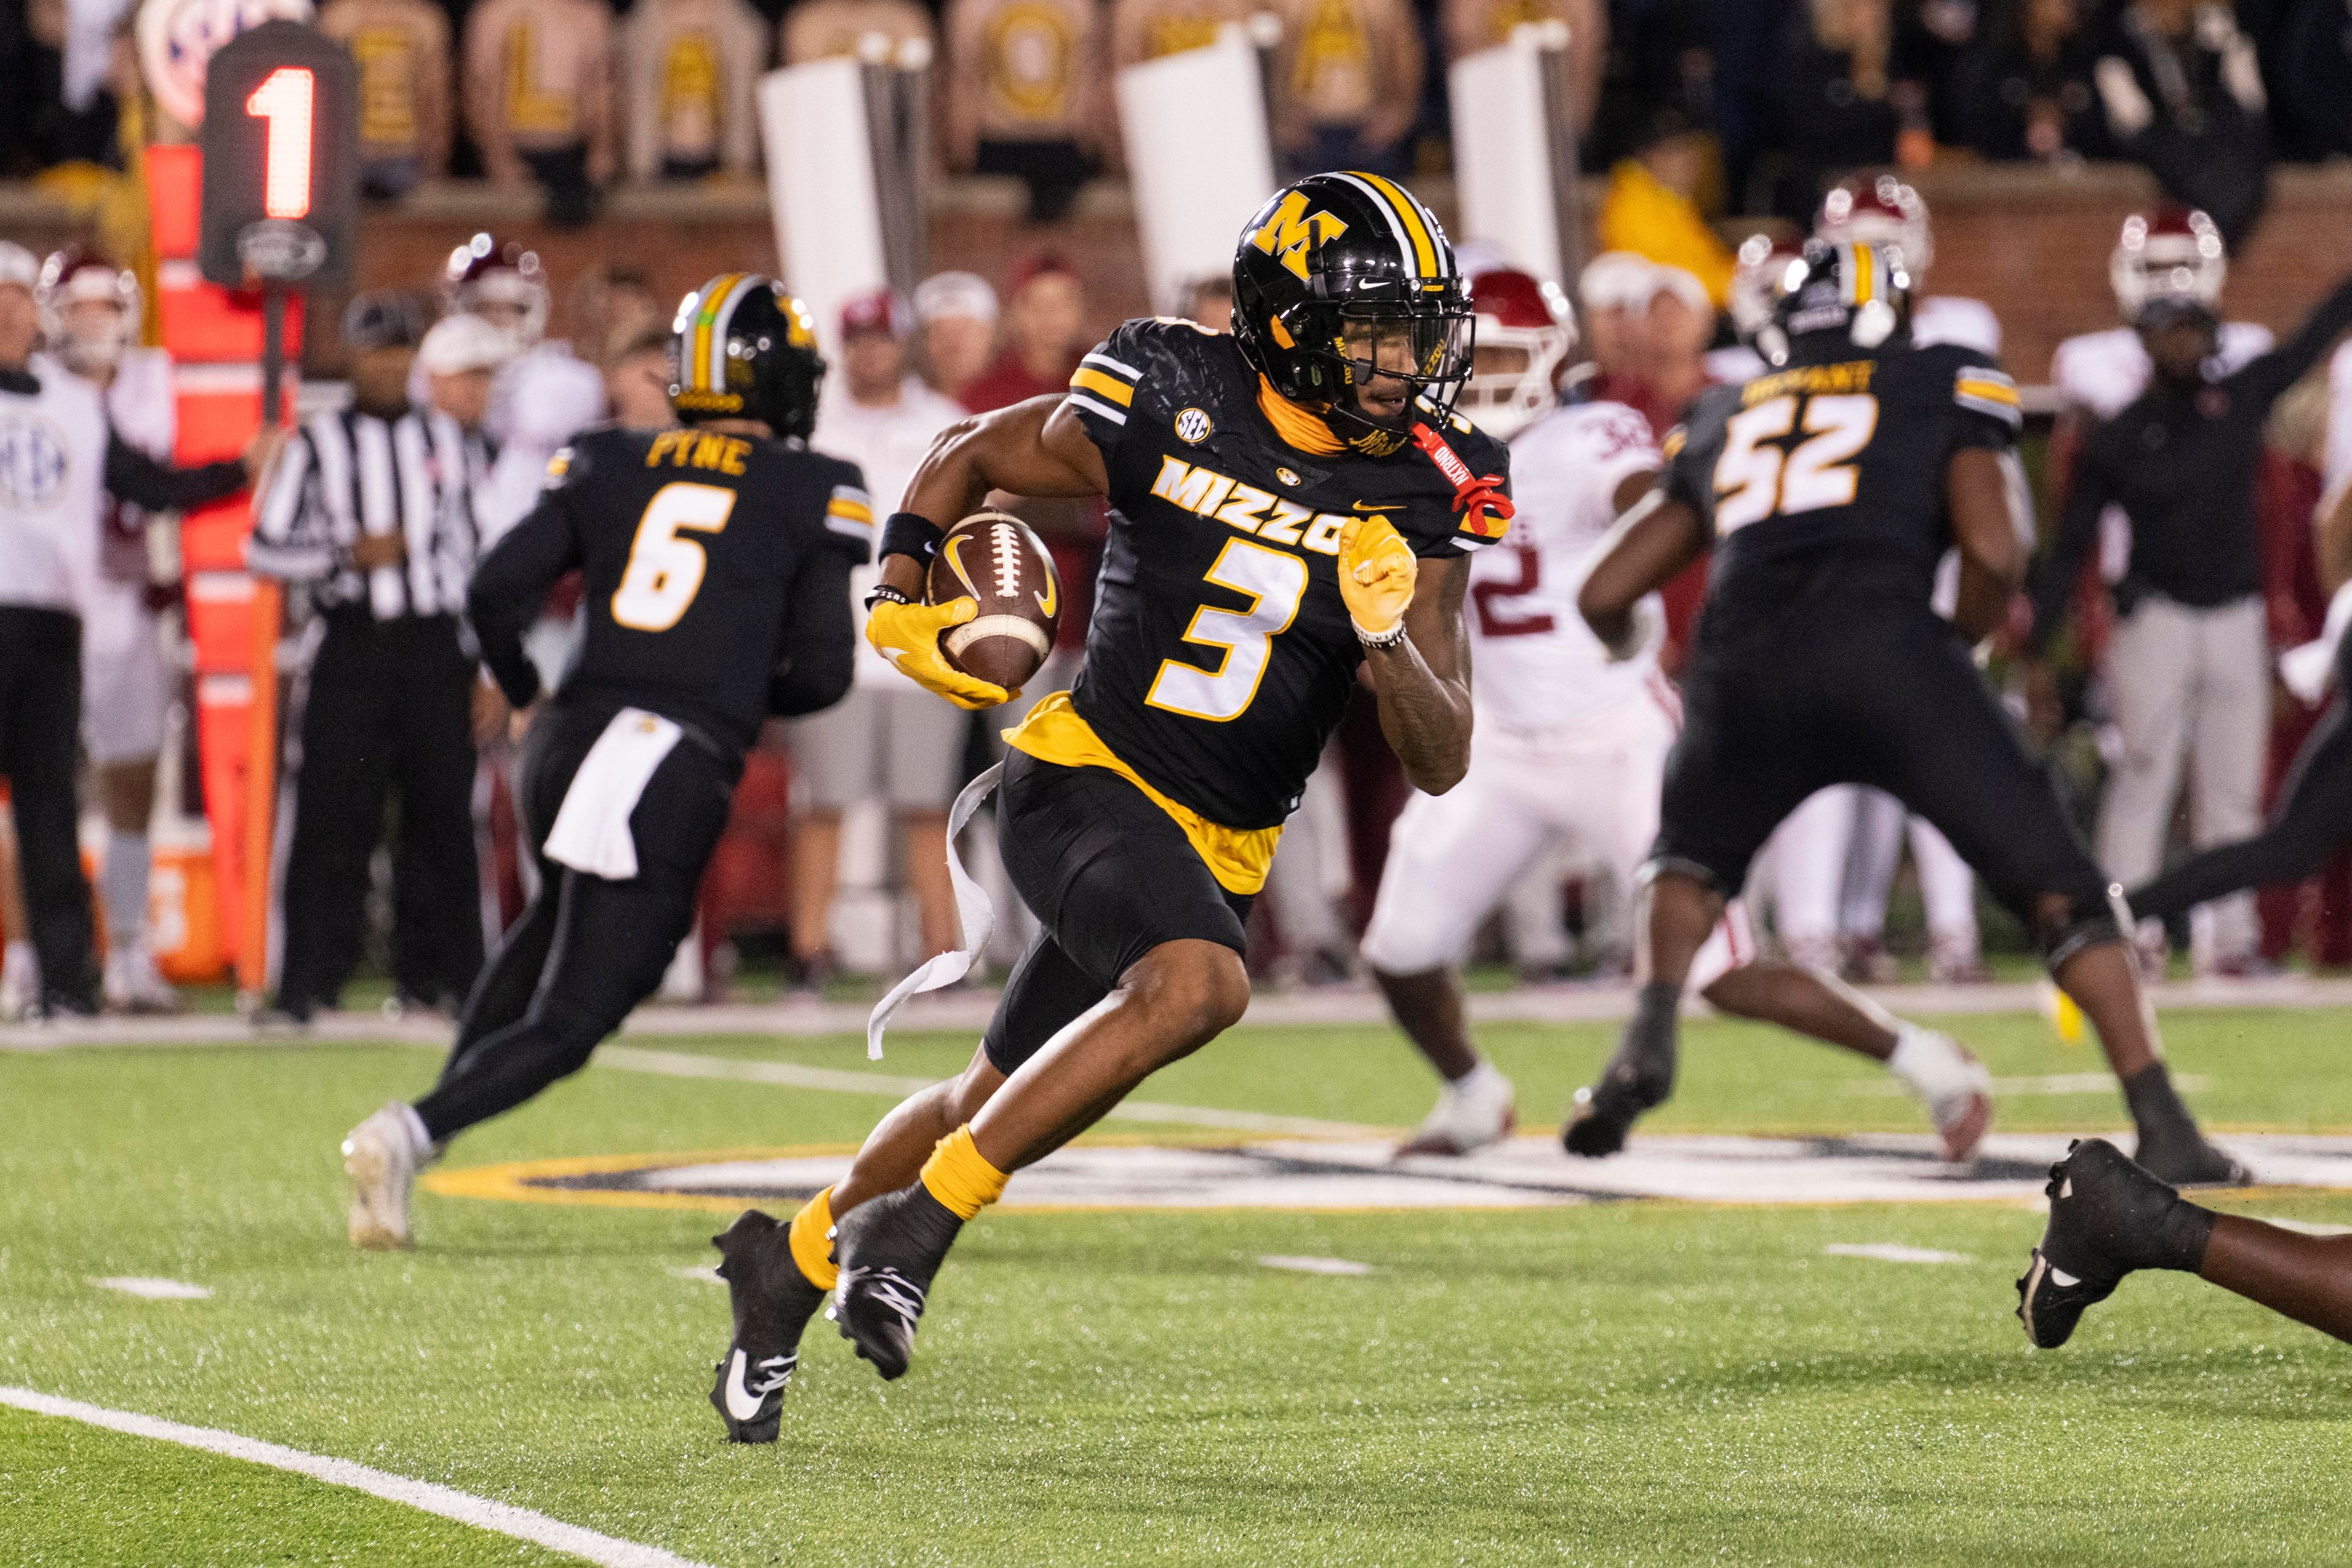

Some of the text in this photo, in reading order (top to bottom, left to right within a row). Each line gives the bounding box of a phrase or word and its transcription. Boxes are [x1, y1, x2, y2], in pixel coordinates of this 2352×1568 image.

[505, 20, 577, 131] L
[247, 67, 315, 219] 1
[1253, 190, 1348, 282] M
[1177, 409, 1210, 440] SEC
[1434, 446, 1469, 486] NXTRND
[1714, 394, 1879, 537] 52
[611, 481, 737, 633] 6
[1150, 454, 1352, 555] MIZZO
[1144, 537, 1308, 722] 3
